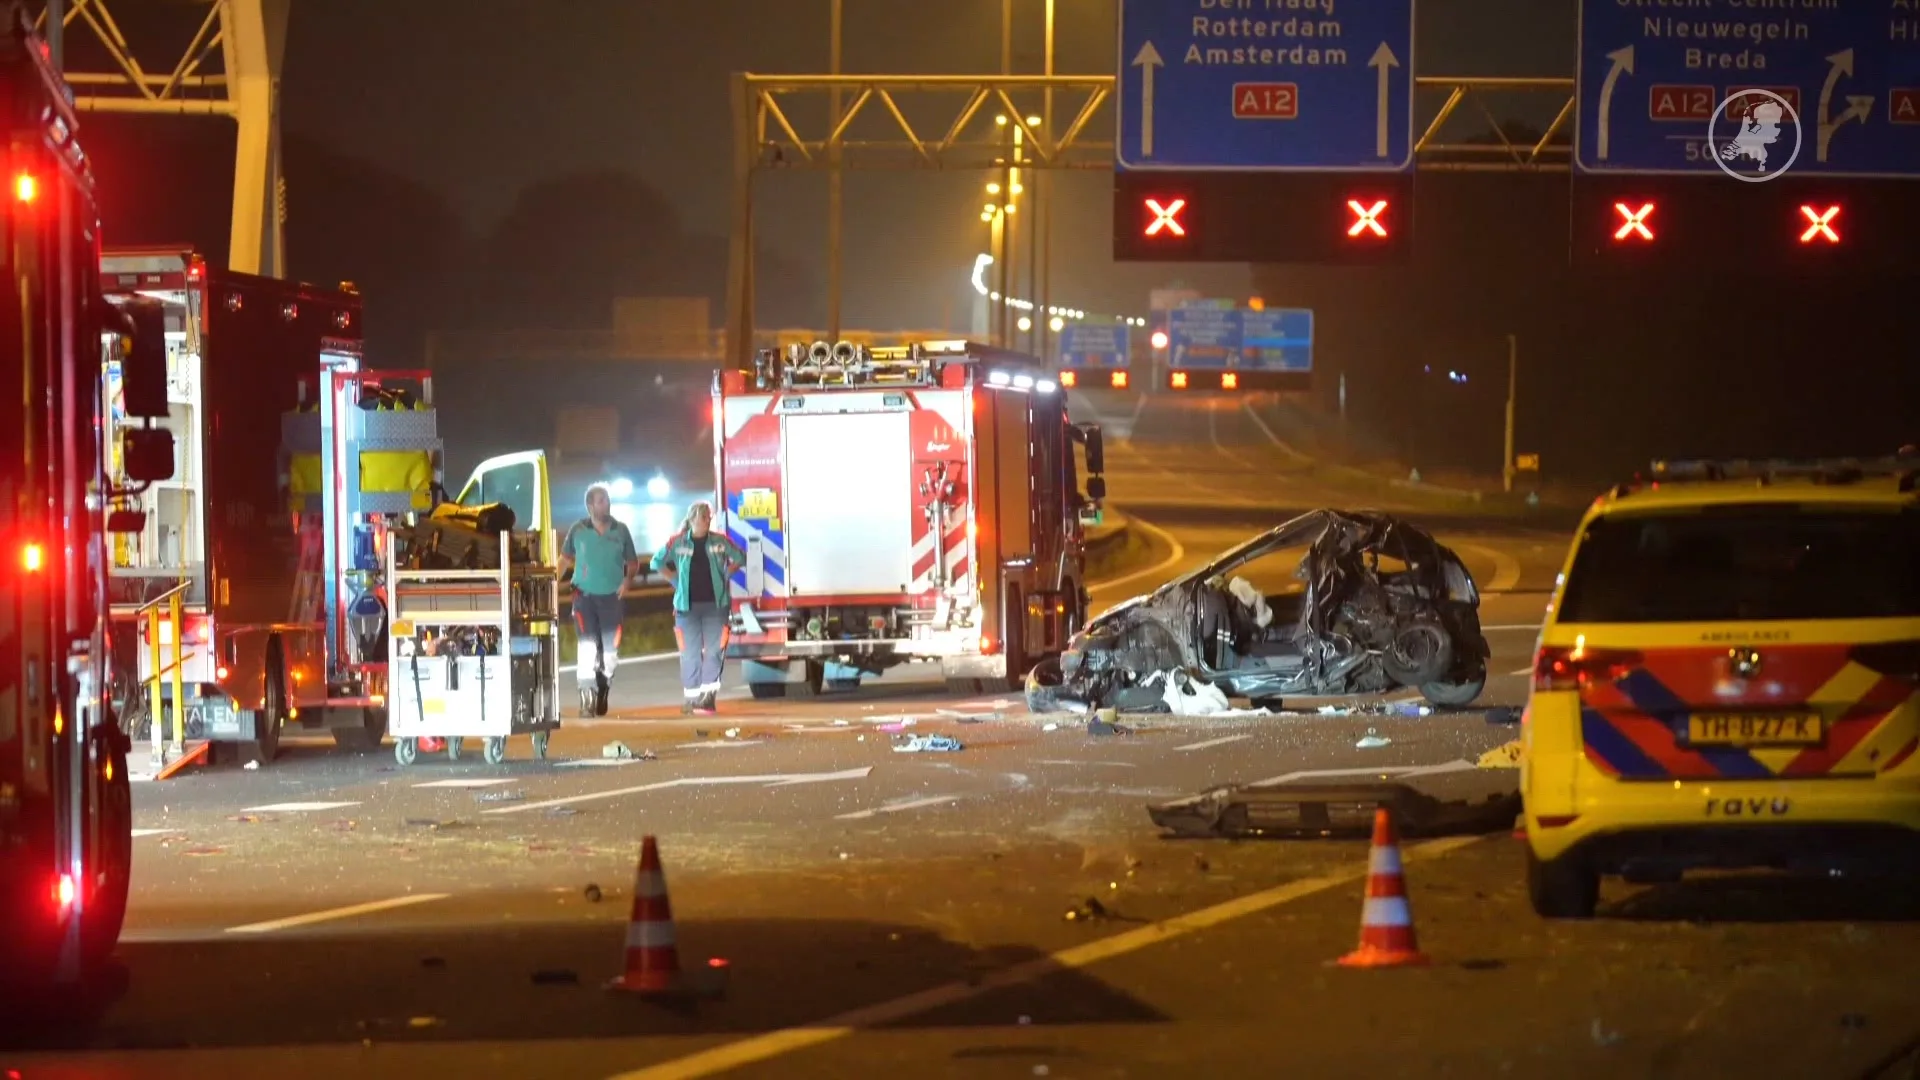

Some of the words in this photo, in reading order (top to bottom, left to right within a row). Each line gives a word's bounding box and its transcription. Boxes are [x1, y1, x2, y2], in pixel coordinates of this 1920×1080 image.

[1193, 17, 1341, 36] Rotterdam
[1644, 17, 1809, 43] Nieuwegein
[1184, 44, 1347, 65] Amsterdam
[1685, 49, 1767, 69] Breda
[1240, 90, 1291, 111] A12
[1656, 93, 1709, 113] A12
[1732, 93, 1793, 115] A7
